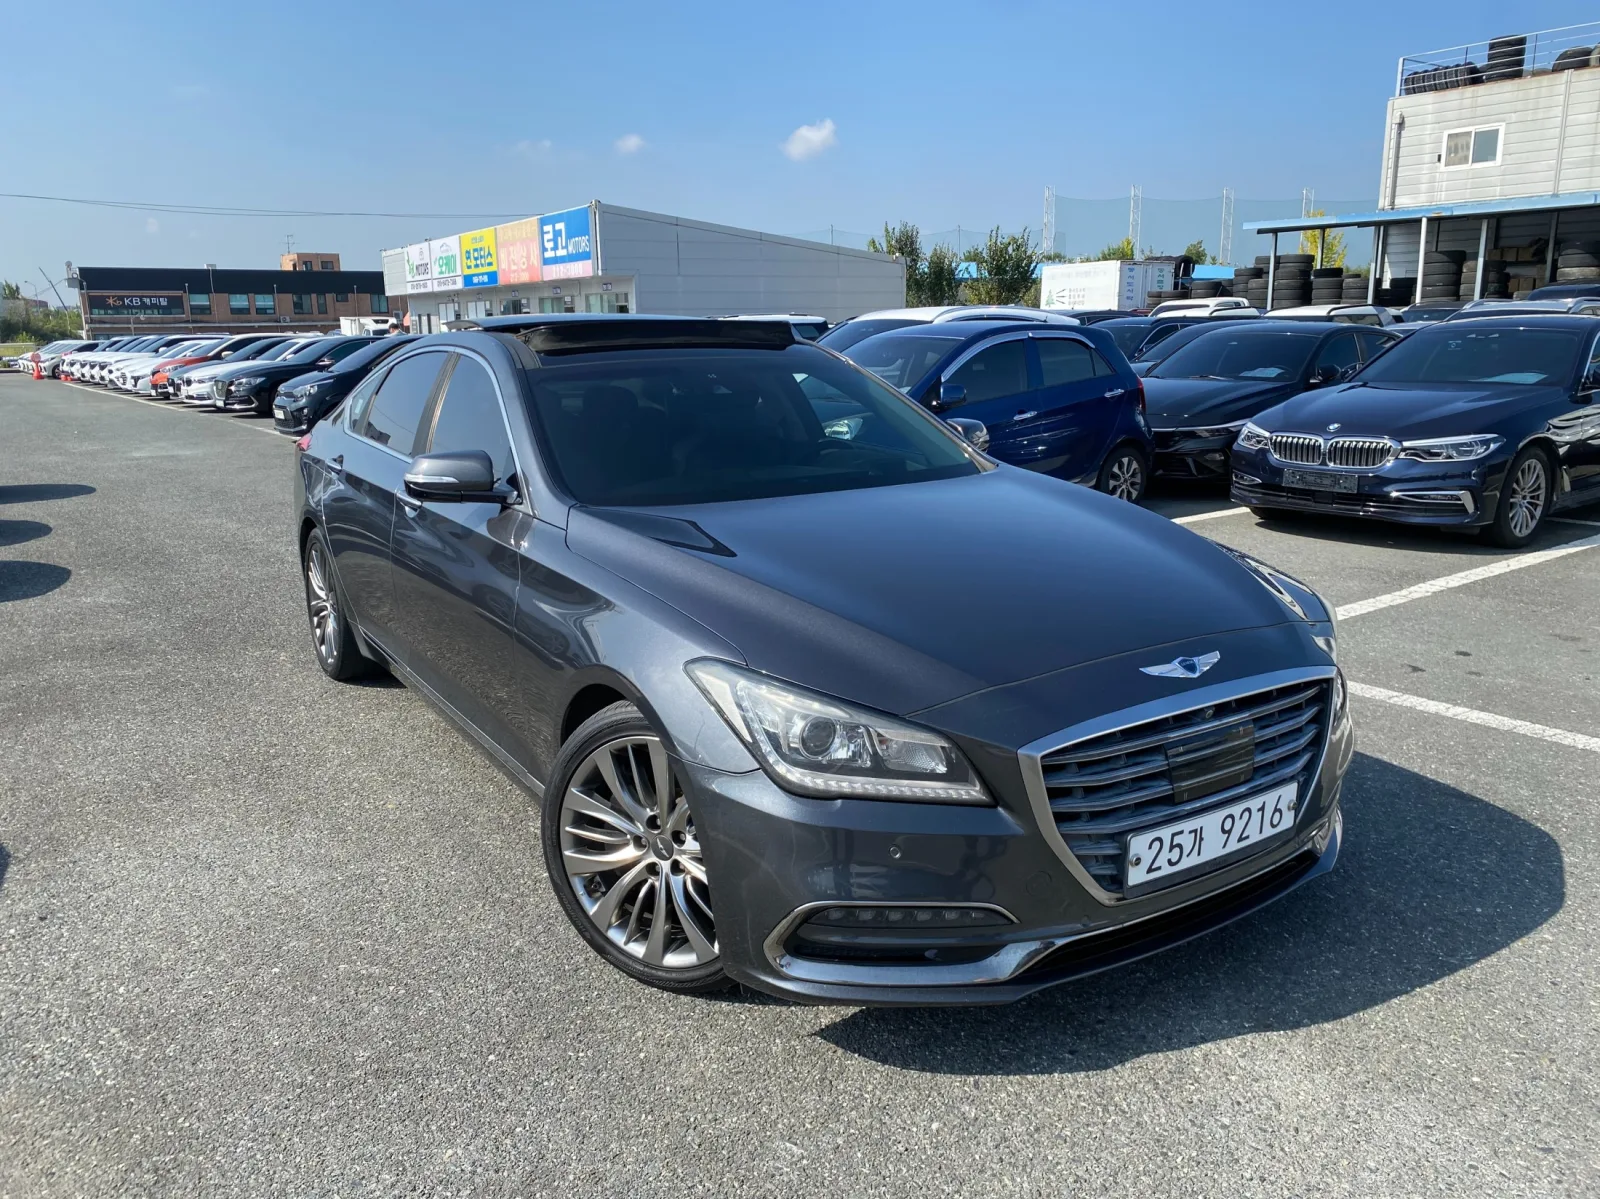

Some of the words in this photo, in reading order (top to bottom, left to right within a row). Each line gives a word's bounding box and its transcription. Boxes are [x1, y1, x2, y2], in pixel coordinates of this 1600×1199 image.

[543, 222, 567, 258] 로고
[567, 235, 590, 255] MOTORS
[1146, 826, 1204, 875] 25가
[1220, 795, 1283, 849] 9216
